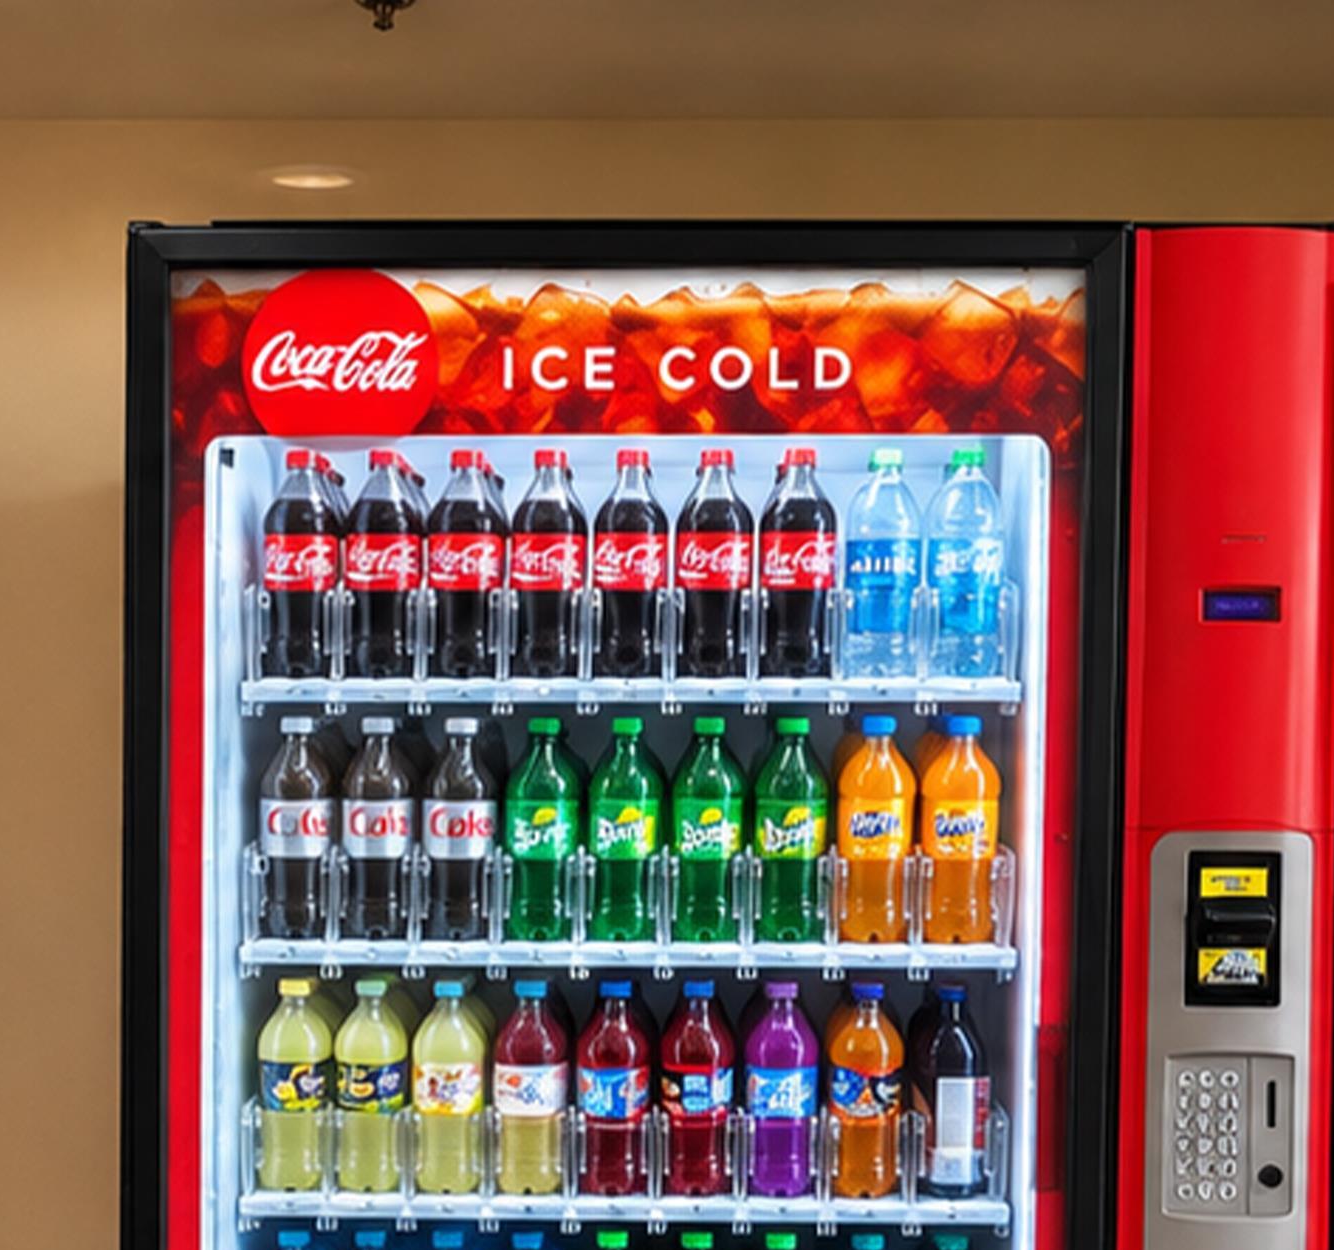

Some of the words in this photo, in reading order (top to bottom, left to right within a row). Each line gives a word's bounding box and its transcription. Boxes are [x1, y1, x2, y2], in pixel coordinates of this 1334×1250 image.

[250, 331, 428, 391] Coca-Cola
[503, 346, 616, 390] ICE
[658, 346, 852, 391] COLD
